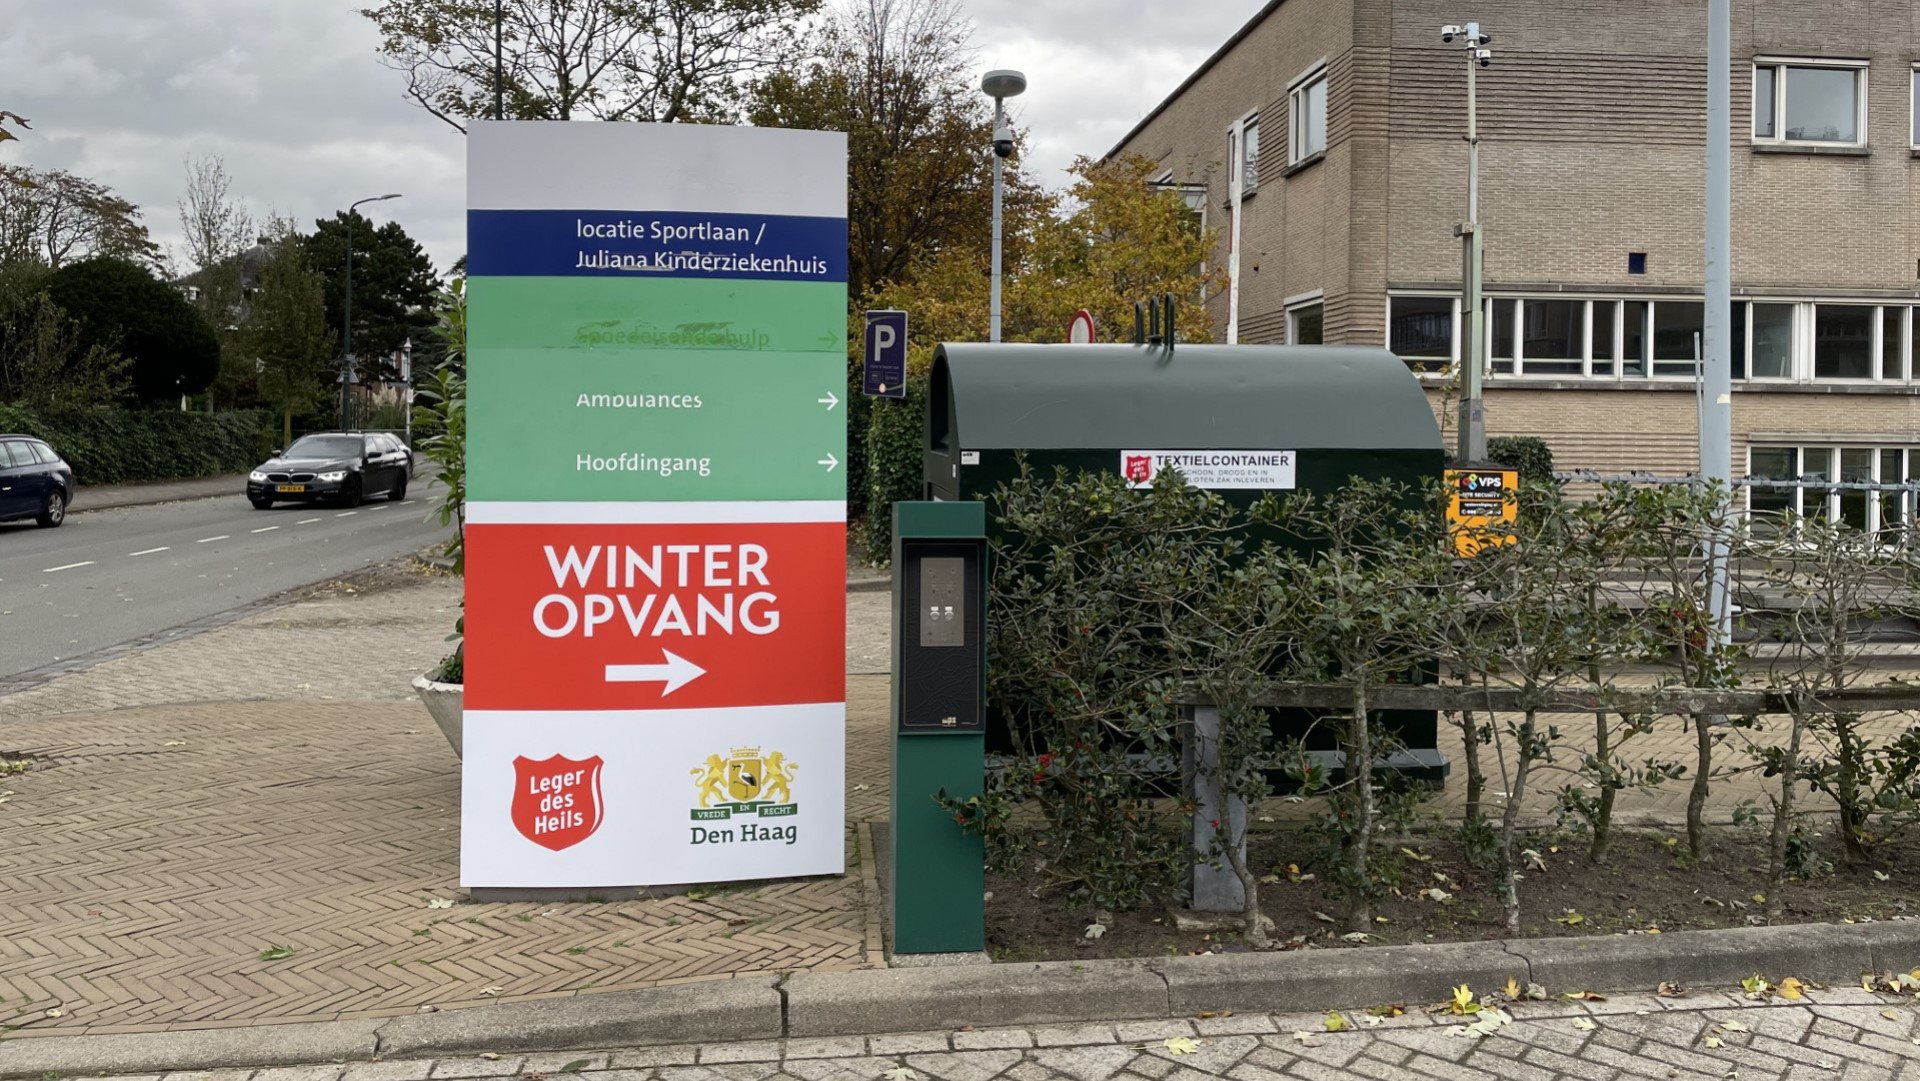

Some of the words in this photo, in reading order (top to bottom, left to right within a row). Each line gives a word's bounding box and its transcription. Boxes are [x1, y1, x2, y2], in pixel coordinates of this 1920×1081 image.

[576, 219, 645, 239] locatie
[650, 221, 749, 244] Sportlaan
[576, 250, 648, 268] Juliana
[654, 251, 827, 274] Kinderziekenhuis
[874, 324, 896, 362] P
[576, 453, 711, 477] Hoofdingang
[1233, 476, 1275, 484] INLEVEREN
[1478, 477, 1501, 487] VPS
[543, 543, 770, 588] WINTER
[532, 591, 780, 638] OPVANG
[529, 769, 585, 795] Leger
[540, 793, 574, 813] des
[697, 811, 726, 819] VREDE
[763, 807, 792, 815] RECHT
[534, 809, 584, 835] Heils
[690, 826, 734, 845] Den
[740, 824, 797, 845] Haag
